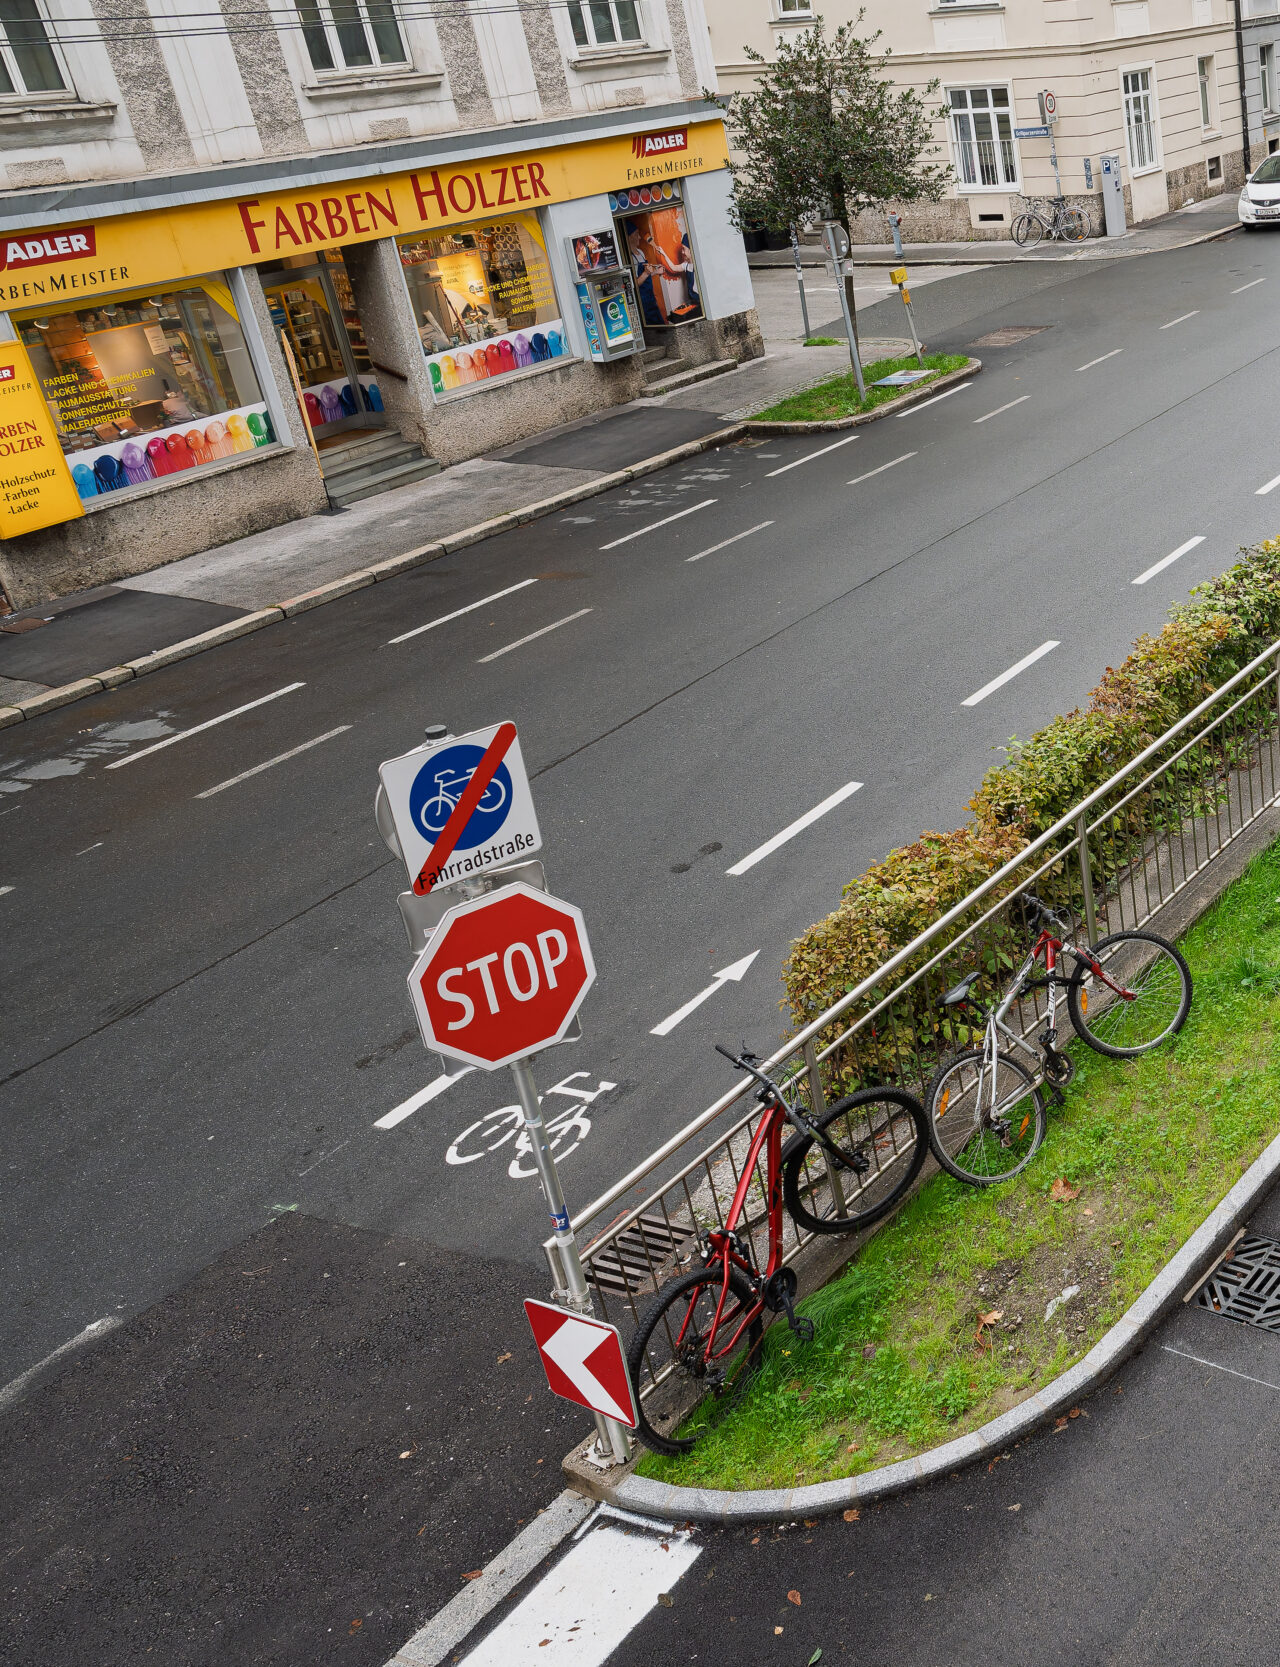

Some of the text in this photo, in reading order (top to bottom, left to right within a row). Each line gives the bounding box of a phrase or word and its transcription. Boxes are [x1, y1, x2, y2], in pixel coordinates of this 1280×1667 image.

[645, 133, 685, 152] ADLER
[237, 162, 551, 254] FARBEN HOLZER
[6, 233, 90, 263] ADLER
[43, 372, 79, 388] FARBEN
[47, 367, 156, 399] LACKE UND CHEMIKALIEN
[51, 383, 137, 410] RAUMAUSSTATTUNG
[56, 399, 128, 422] SONNENSCHUTZ
[60, 409, 132, 433] MALERARBEITEN
[417, 833, 535, 890] Fahrradstraße
[437, 928, 568, 1030] STOP
